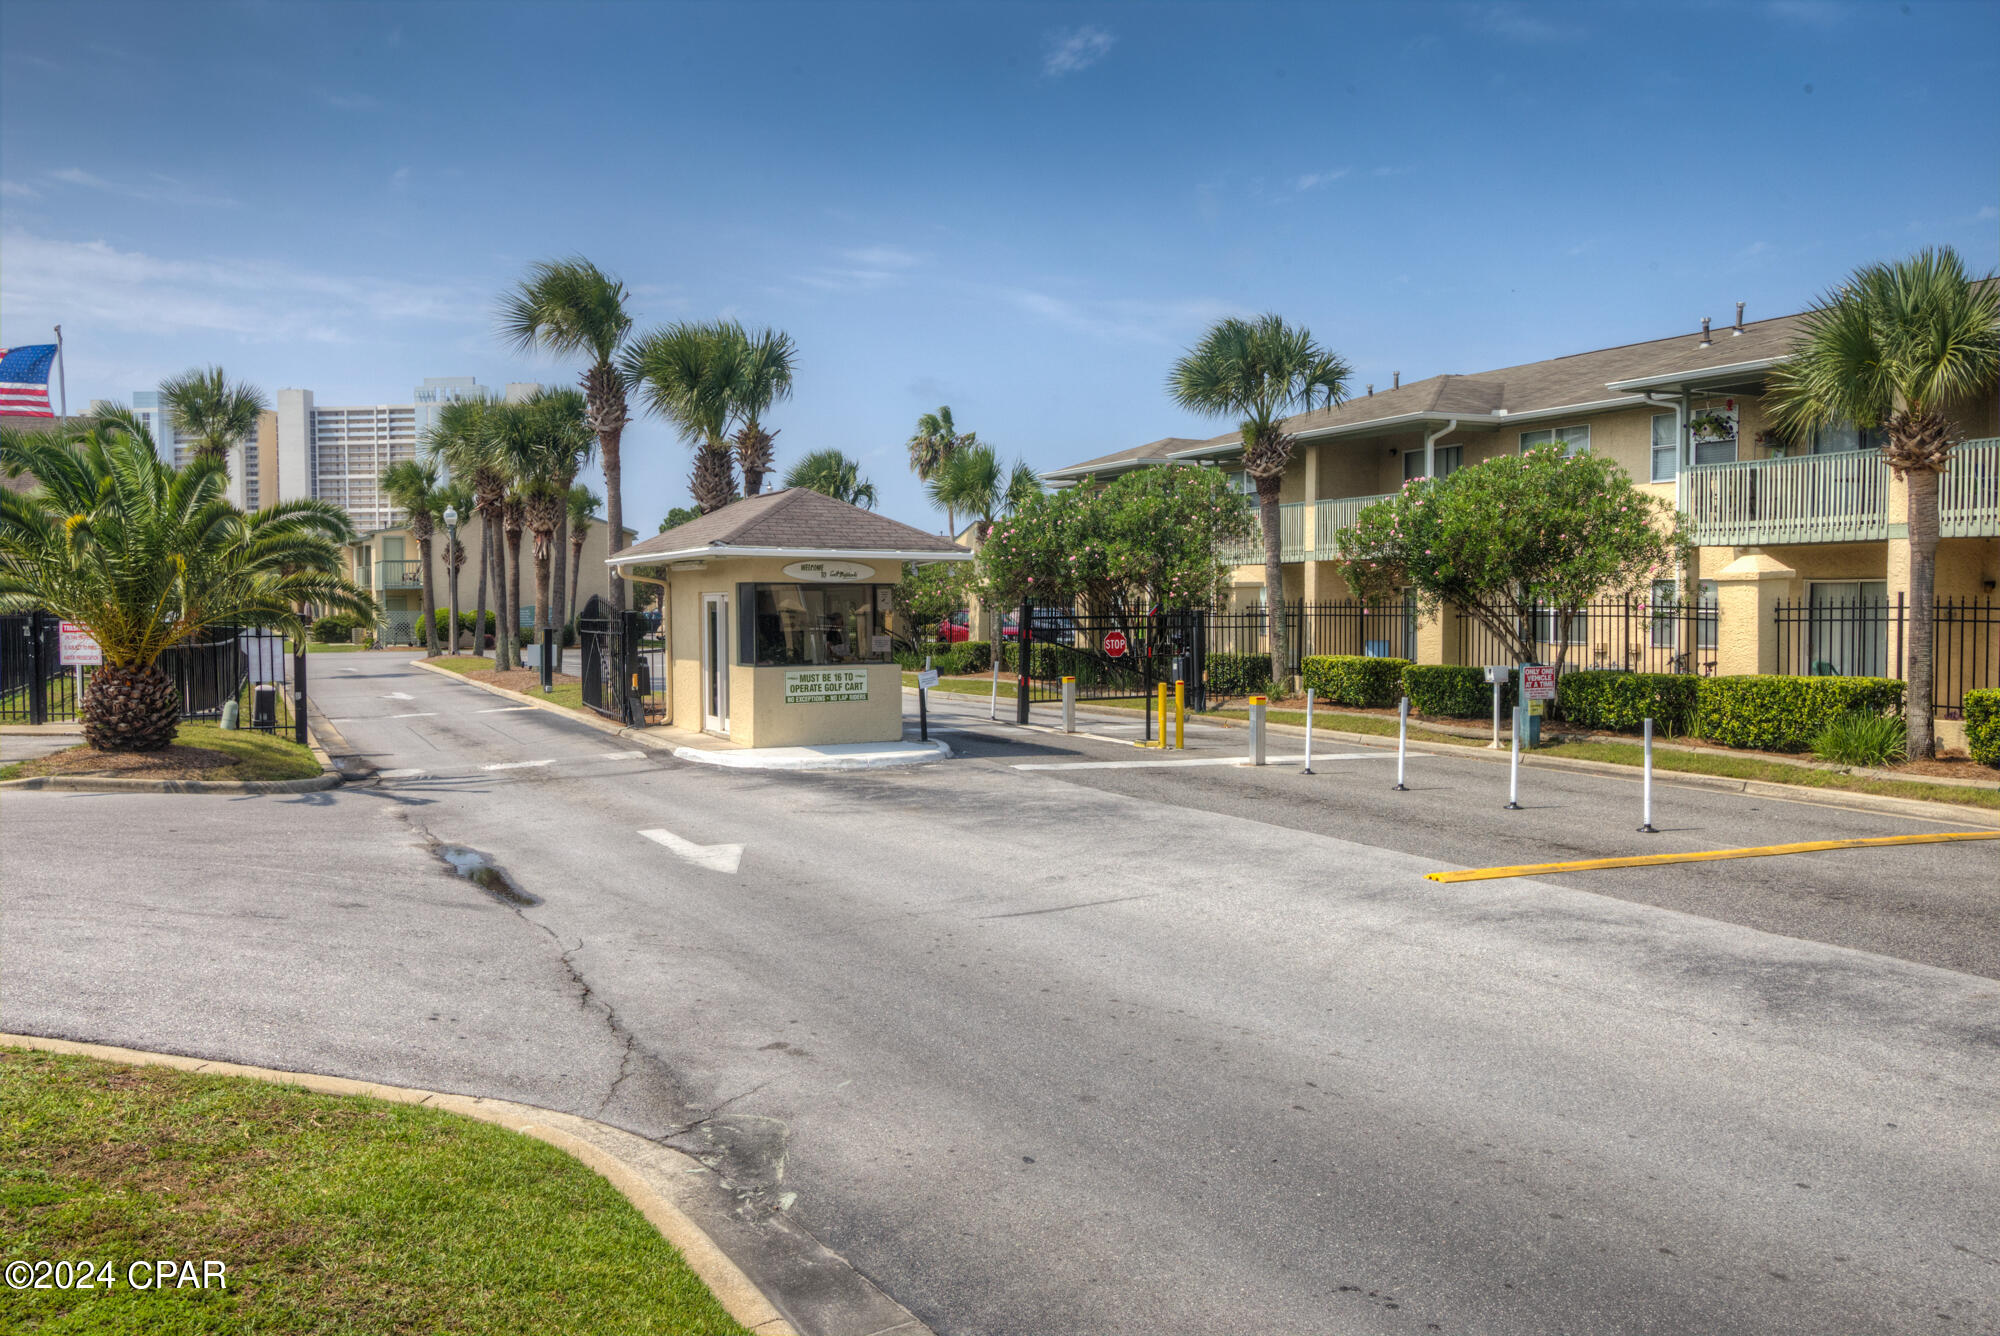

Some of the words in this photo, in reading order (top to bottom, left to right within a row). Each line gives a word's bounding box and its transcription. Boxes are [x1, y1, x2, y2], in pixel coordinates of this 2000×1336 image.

[1106, 640, 1125, 650] STOP
[800, 674, 820, 683] MUST
[822, 674, 832, 682] BE
[834, 673, 842, 681] 16
[844, 672, 854, 681] TO
[790, 684, 822, 693] OPERATE
[824, 683, 842, 692] GOLF
[845, 682, 863, 691] CART
